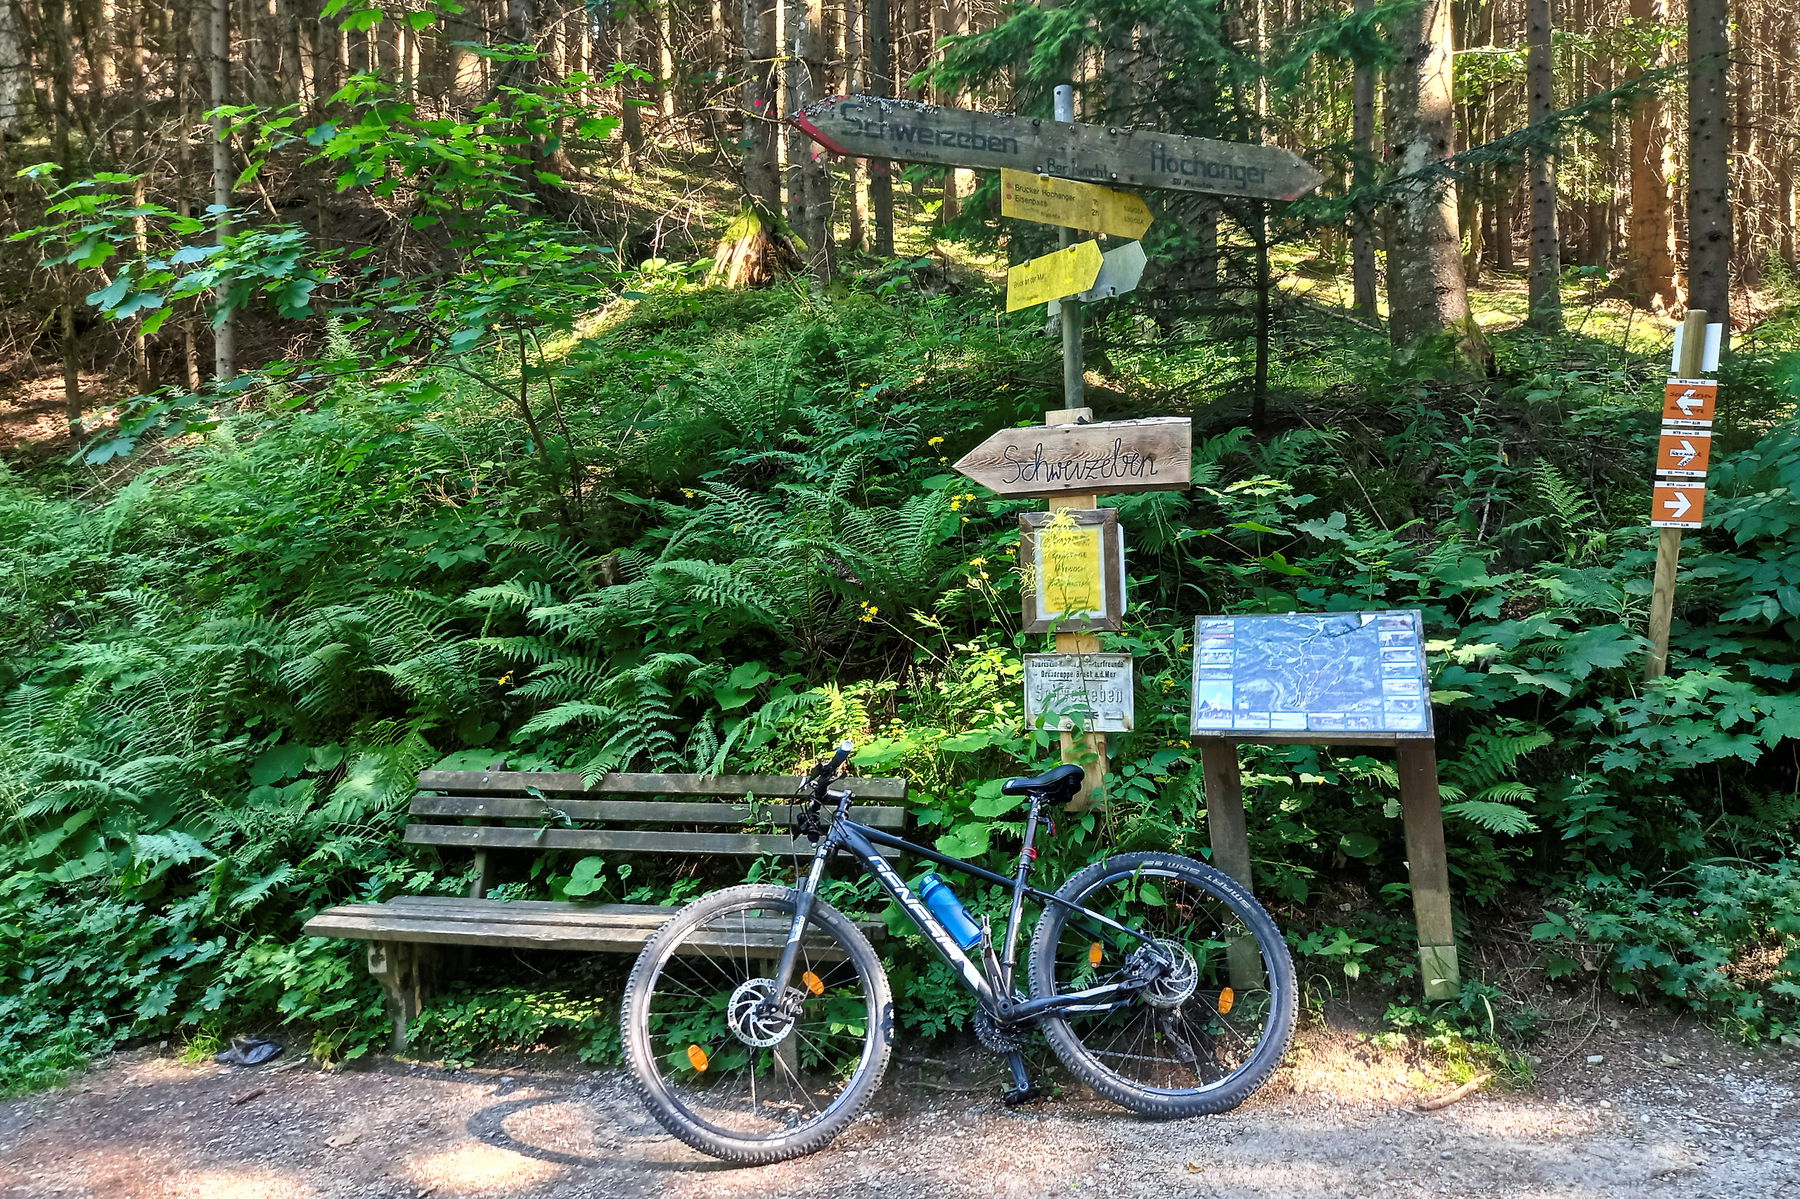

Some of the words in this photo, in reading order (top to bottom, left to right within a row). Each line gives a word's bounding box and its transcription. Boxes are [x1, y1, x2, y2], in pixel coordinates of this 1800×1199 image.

[840, 102, 1018, 155] Schweizeben
[1149, 140, 1269, 189] Hochanger
[1014, 184, 1040, 195] Brucker
[1041, 189, 1076, 202] Hochanger
[1002, 437, 1158, 485] Schweizeben
[1166, 862, 1201, 875] SAM
[1203, 874, 1252, 909] SMART
